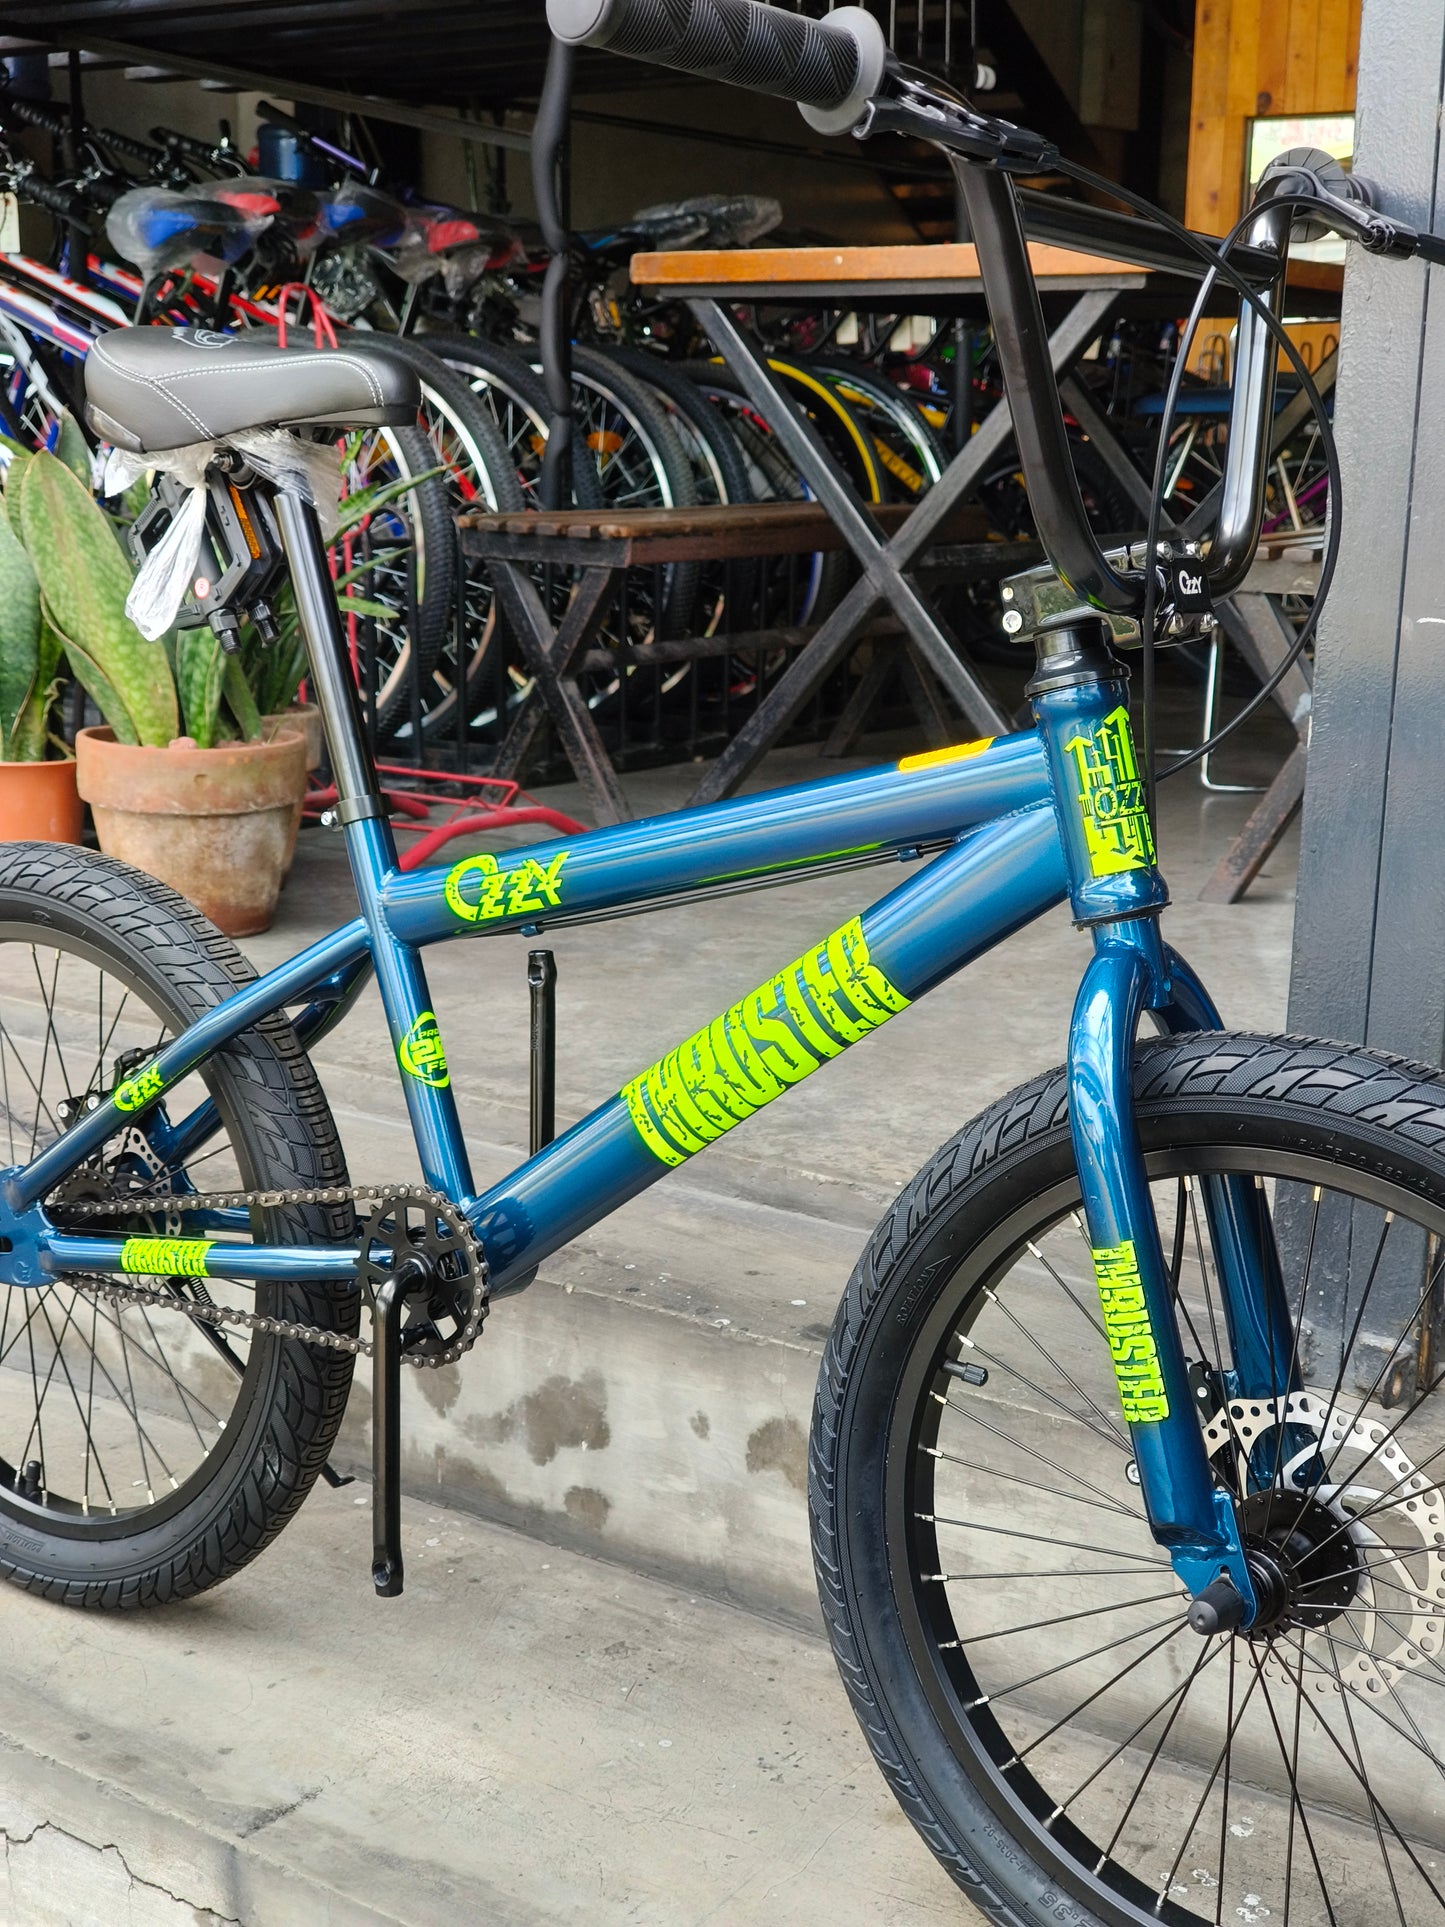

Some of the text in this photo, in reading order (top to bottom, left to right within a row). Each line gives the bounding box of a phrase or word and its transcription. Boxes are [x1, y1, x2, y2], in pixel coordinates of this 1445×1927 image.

[1179, 570, 1202, 594] OZZY
[445, 851, 571, 921] OZZY
[620, 915, 912, 1167] THRUSTER
[121, 1238, 216, 1277] THRUSTER
[1092, 1240, 1170, 1422] THRUSTER
